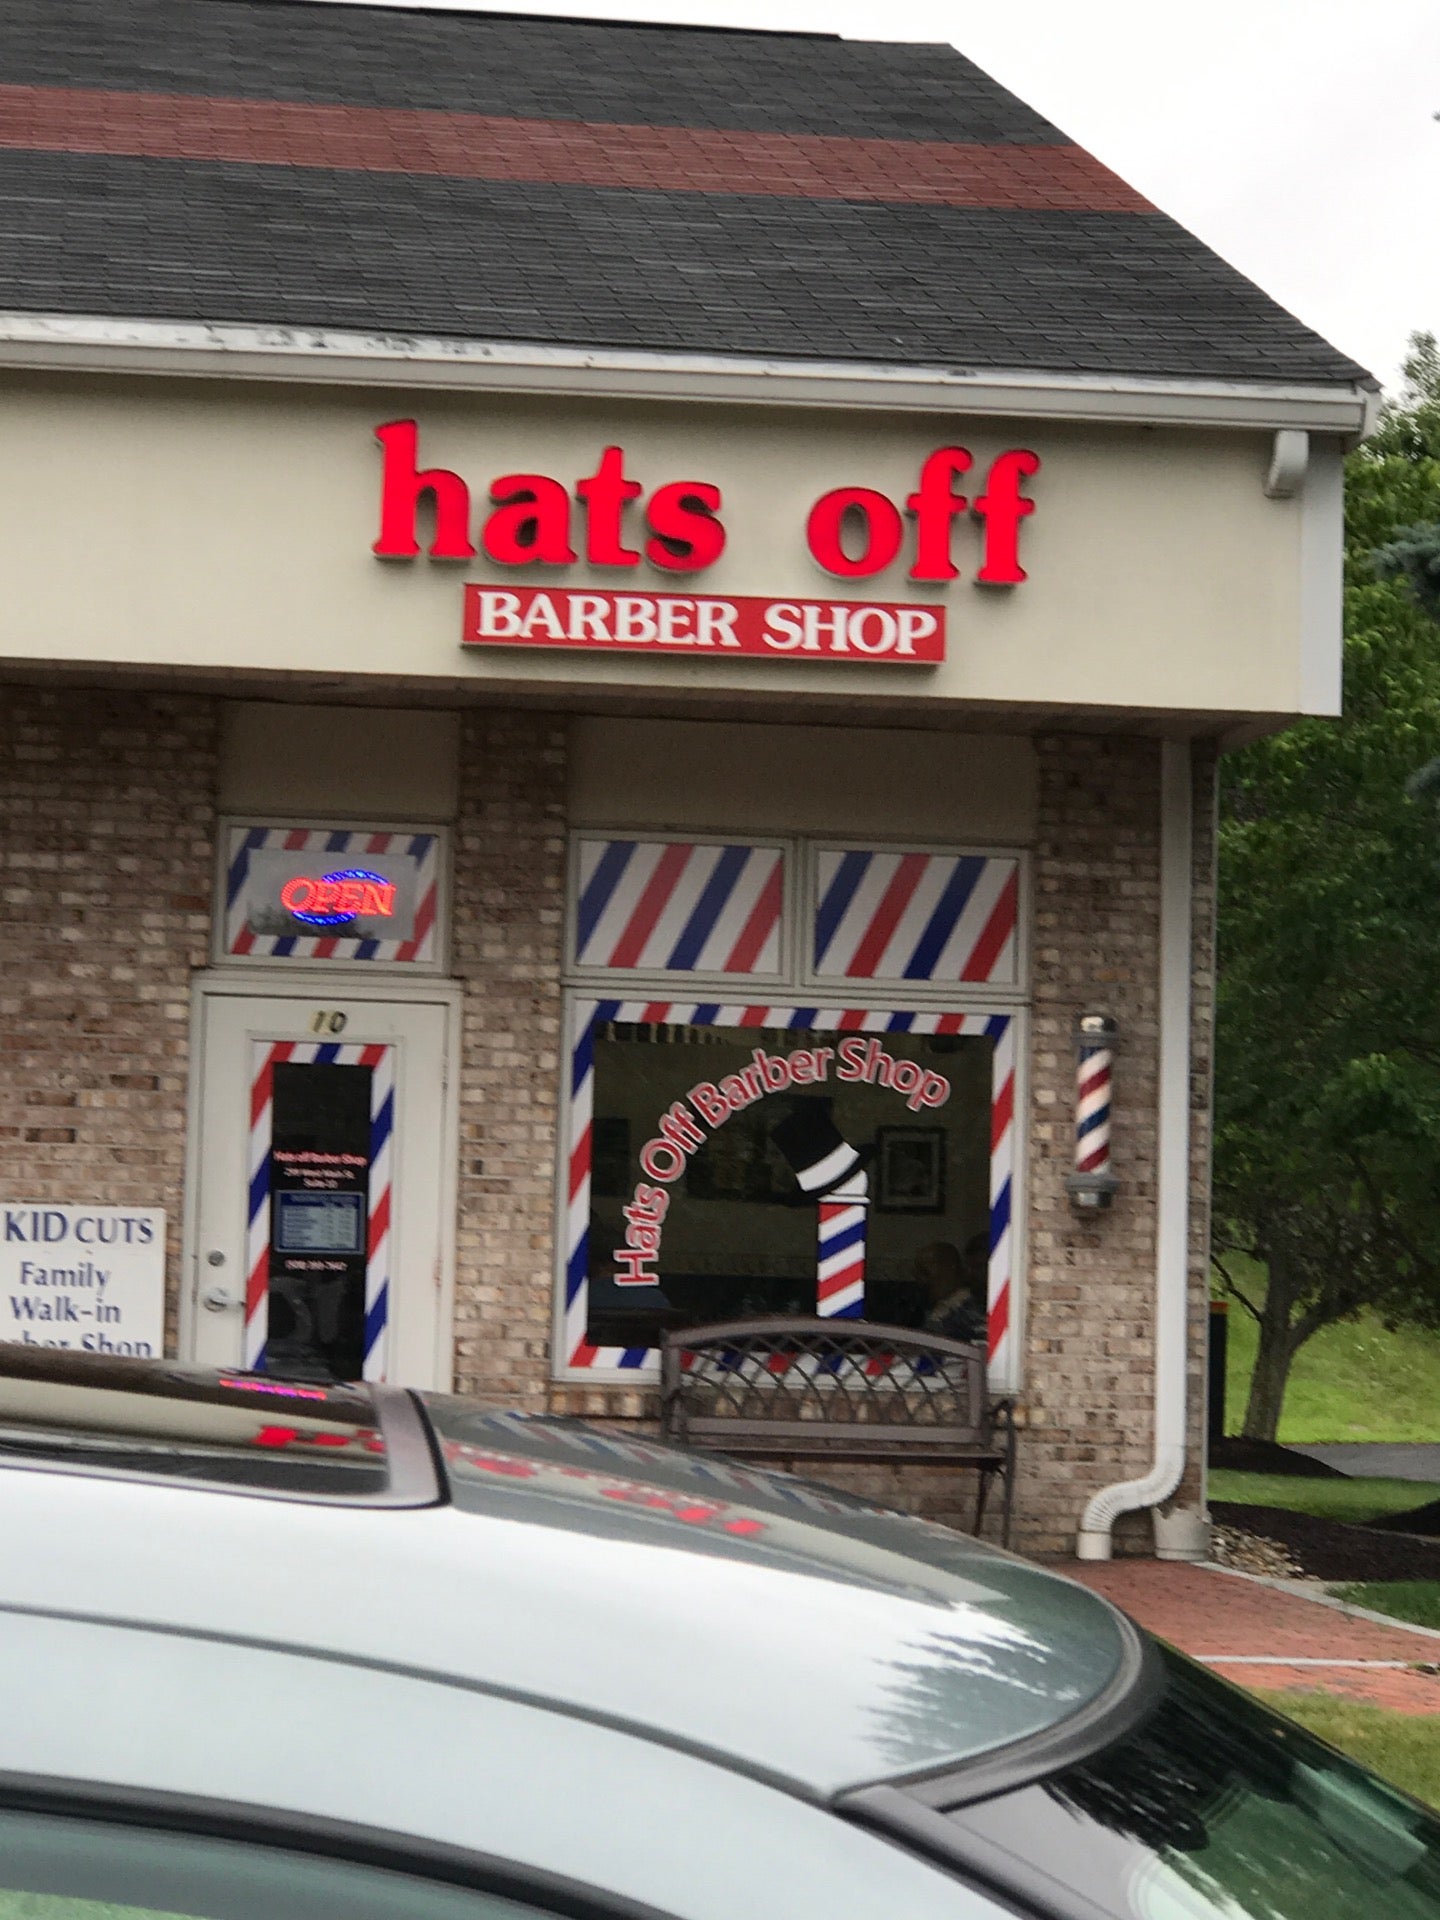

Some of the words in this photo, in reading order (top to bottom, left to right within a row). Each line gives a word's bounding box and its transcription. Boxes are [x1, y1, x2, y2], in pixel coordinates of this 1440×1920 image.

[372, 419, 726, 572] hats
[806, 446, 1040, 586] off
[477, 591, 741, 648] BARBER
[761, 603, 937, 656] SHOP
[281, 877, 396, 916] OPEN
[311, 1010, 348, 1034] 10
[686, 1047, 836, 1129] Barber
[836, 1037, 951, 1112] Shop
[640, 1101, 707, 1183] Off
[4, 1210, 69, 1242] KID
[75, 1217, 155, 1244] CUTS
[613, 1183, 670, 1287] Hats
[9, 1295, 122, 1324] Walk-in
[19, 1261, 112, 1297] Family
